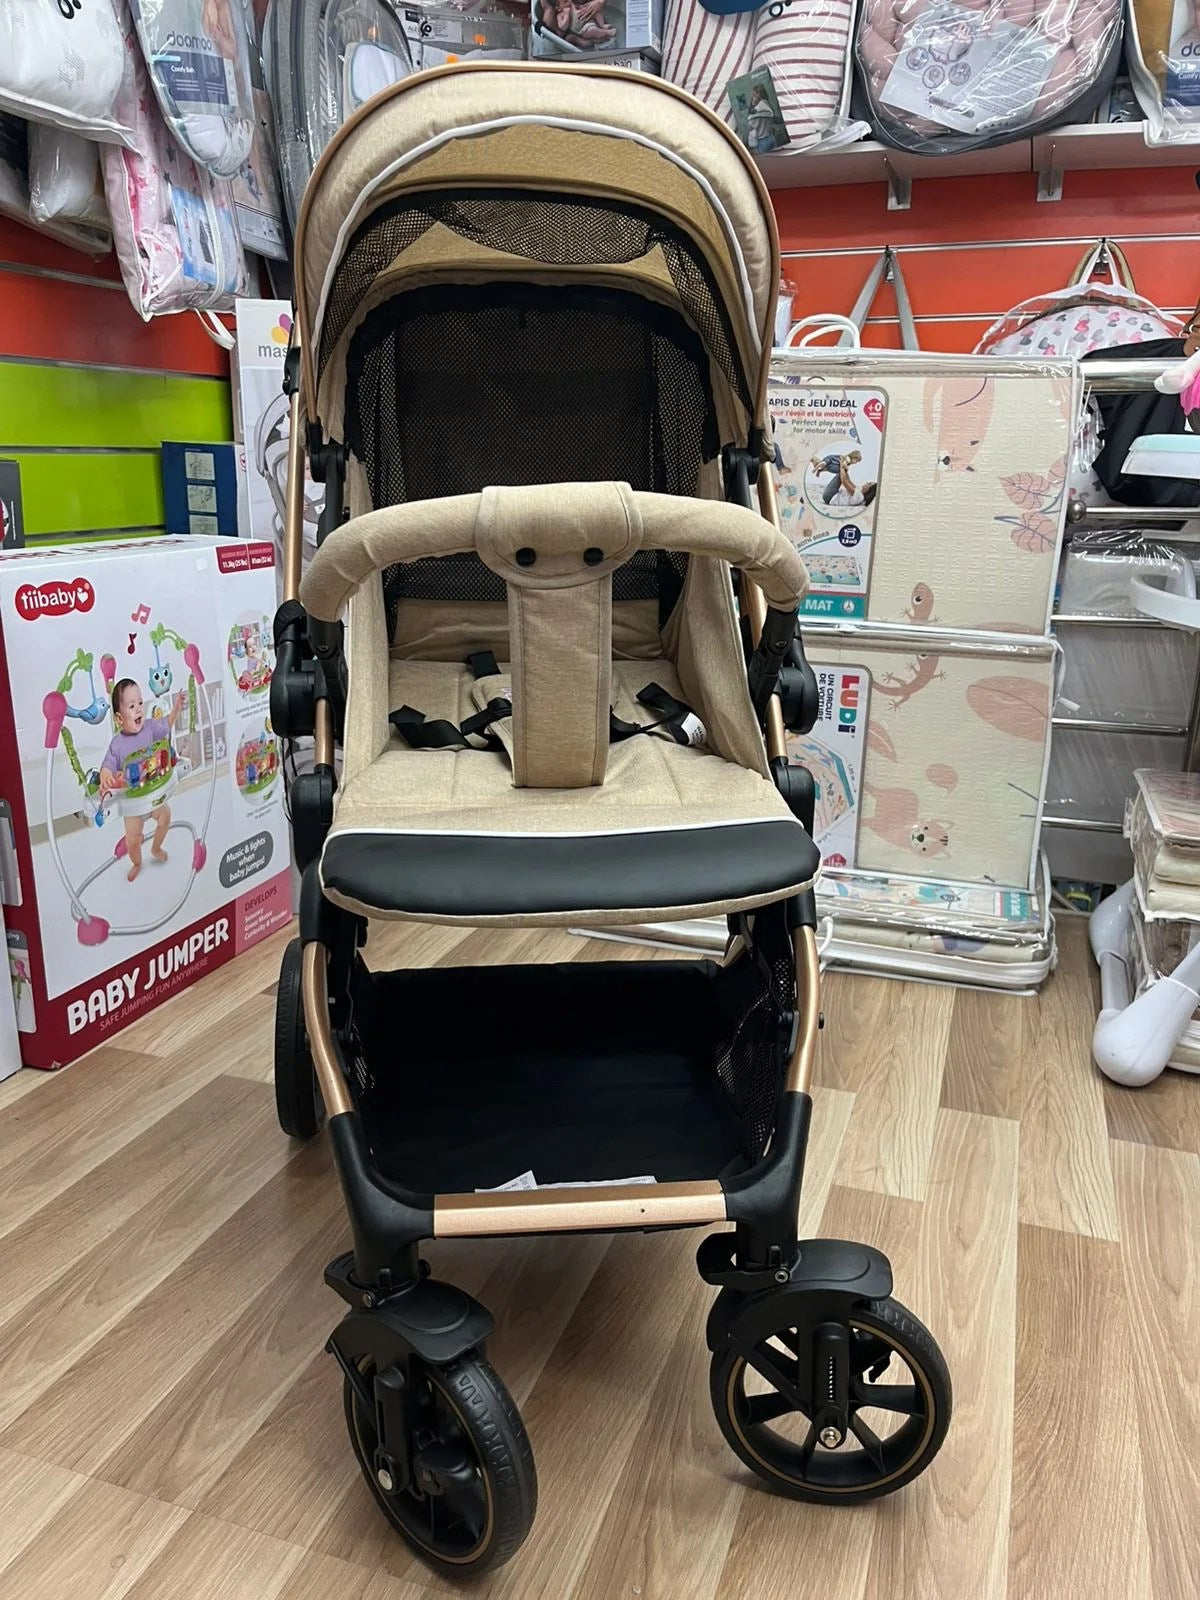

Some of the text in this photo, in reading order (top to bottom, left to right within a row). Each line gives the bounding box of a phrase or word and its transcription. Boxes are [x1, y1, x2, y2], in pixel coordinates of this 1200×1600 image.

[258, 345, 288, 358] mas
[769, 398, 790, 407] APIS
[793, 398, 805, 407] DE
[808, 399, 827, 407] JEU
[805, 599, 834, 611] MAT
[819, 673, 827, 685] DE
[825, 674, 835, 721] UN CIRCUIT
[226, 837, 266, 863] Music & lights
[238, 853, 256, 867] when
[229, 867, 245, 882] baby
[244, 885, 278, 912] DEVELOPS
[67, 917, 230, 1035] BABY JUMPER
[100, 957, 208, 1031] SAFE JUMPING FUN ANYWHERE
